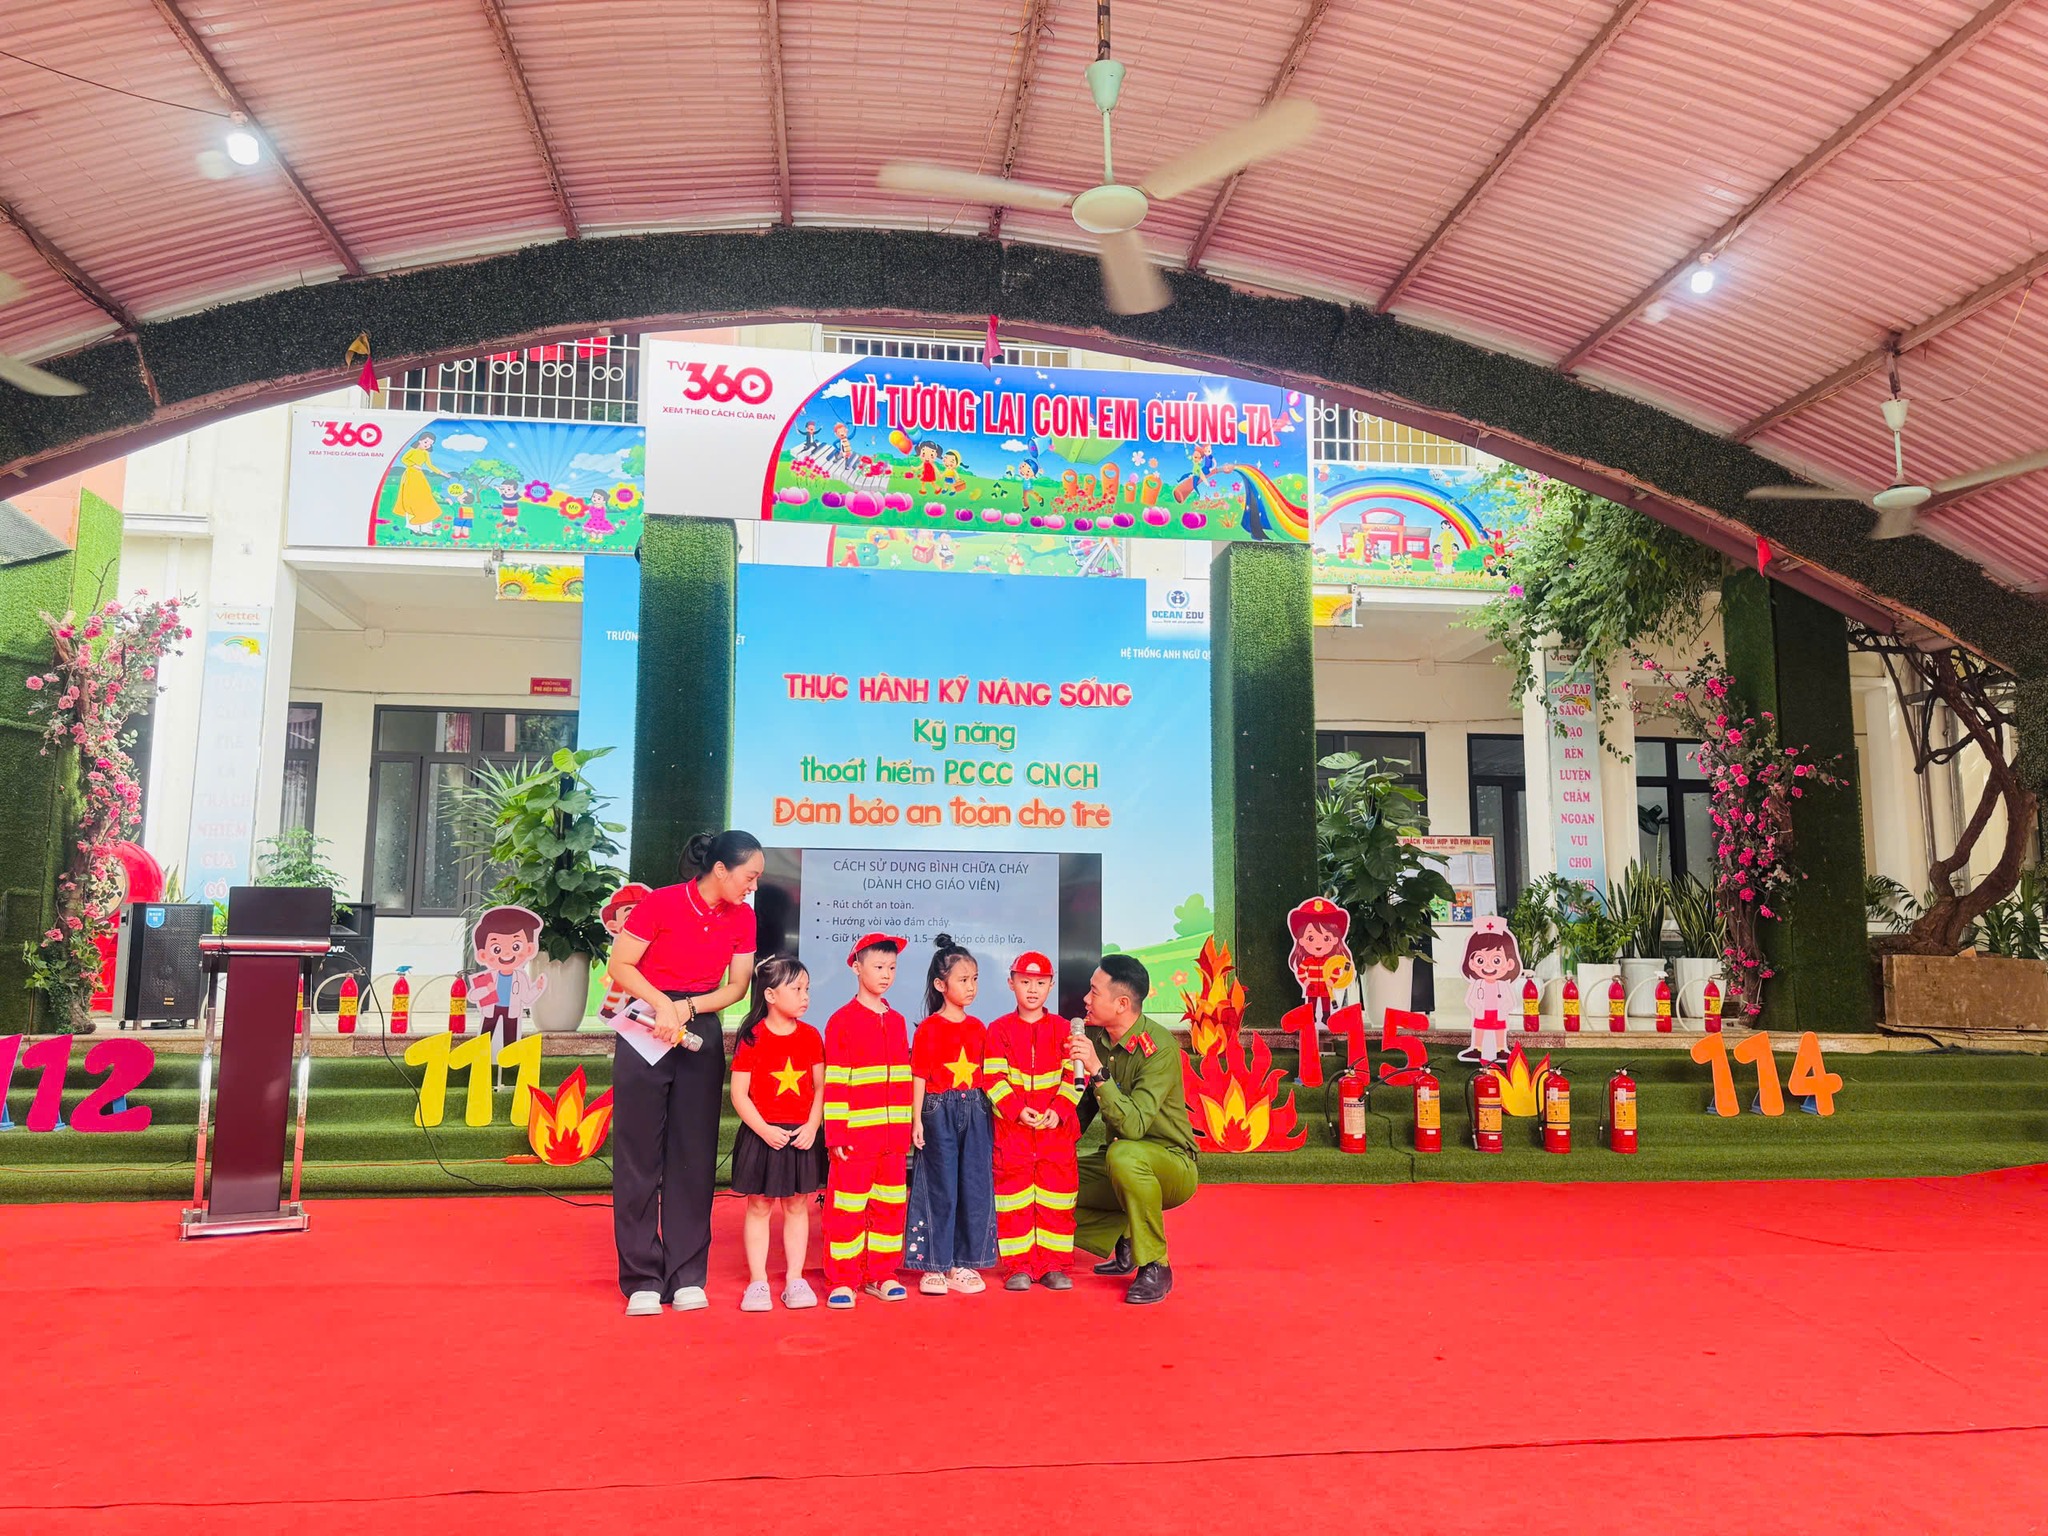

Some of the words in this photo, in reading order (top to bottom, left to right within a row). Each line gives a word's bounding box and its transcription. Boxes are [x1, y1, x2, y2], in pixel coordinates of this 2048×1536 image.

[663, 406, 683, 414] XEM
[685, 407, 710, 416] THEO
[711, 408, 735, 418] CÁCH
[851, 374, 877, 427] VÌ
[886, 380, 976, 433] TƯƠNG
[984, 391, 1025, 436] LAI
[1033, 394, 1090, 438] CON
[1097, 397, 1138, 440] EM
[1146, 392, 1237, 445] CHÚNG
[1243, 403, 1276, 447] TA
[1152, 610, 1183, 619] OCEAN
[1185, 611, 1204, 619] EDU
[606, 629, 639, 641] TRƯỜN
[1121, 647, 1131, 660] HỆ
[1163, 650, 1181, 660] ANH
[784, 673, 849, 702] THỰC
[859, 672, 929, 703] HÀNH
[938, 675, 969, 704] KỸ
[978, 677, 1051, 707] NĂNG
[1059, 676, 1132, 707] SỐNG
[913, 718, 947, 750] Kỹ
[954, 720, 1017, 752] năng
[801, 756, 866, 783] thoát
[876, 756, 935, 784] hiểm
[944, 759, 1013, 785] PCCC
[1026, 762, 1099, 788] CNCH
[773, 796, 841, 826] Đảm
[849, 793, 899, 826] bảo
[906, 803, 942, 825] an
[949, 796, 1011, 827] toàn
[1018, 798, 1066, 827] cho
[1071, 800, 1112, 828] trẻ
[1560, 813, 1595, 825] NGOAN
[1570, 835, 1588, 847] VUI
[833, 858, 866, 872] CÁCH
[869, 857, 887, 872] SỬ
[890, 861, 926, 874] DỤNG
[929, 860, 959, 873] BÌNH
[962, 860, 996, 874] CHỮA
[999, 861, 1029, 874] CHÁY
[863, 876, 902, 891] (DÀNH
[905, 879, 932, 890] CHO
[935, 877, 965, 890] GIÁO
[968, 877, 1000, 893] VIÊN)
[832, 899, 849, 909] Rút
[851, 898, 873, 909] chốt
[875, 901, 887, 909] an
[890, 900, 914, 910] toàn.
[832, 916, 865, 927] Hướng
[868, 916, 882, 926] vòi
[884, 917, 901, 926] vào
[904, 917, 925, 926] đám
[831, 933, 850, 943] Giữ
[954, 934, 973, 944] bóp
[1280, 1002, 1430, 1088] 115
[404, 1031, 542, 1127] 111
[1691, 1031, 1844, 1117] 114
